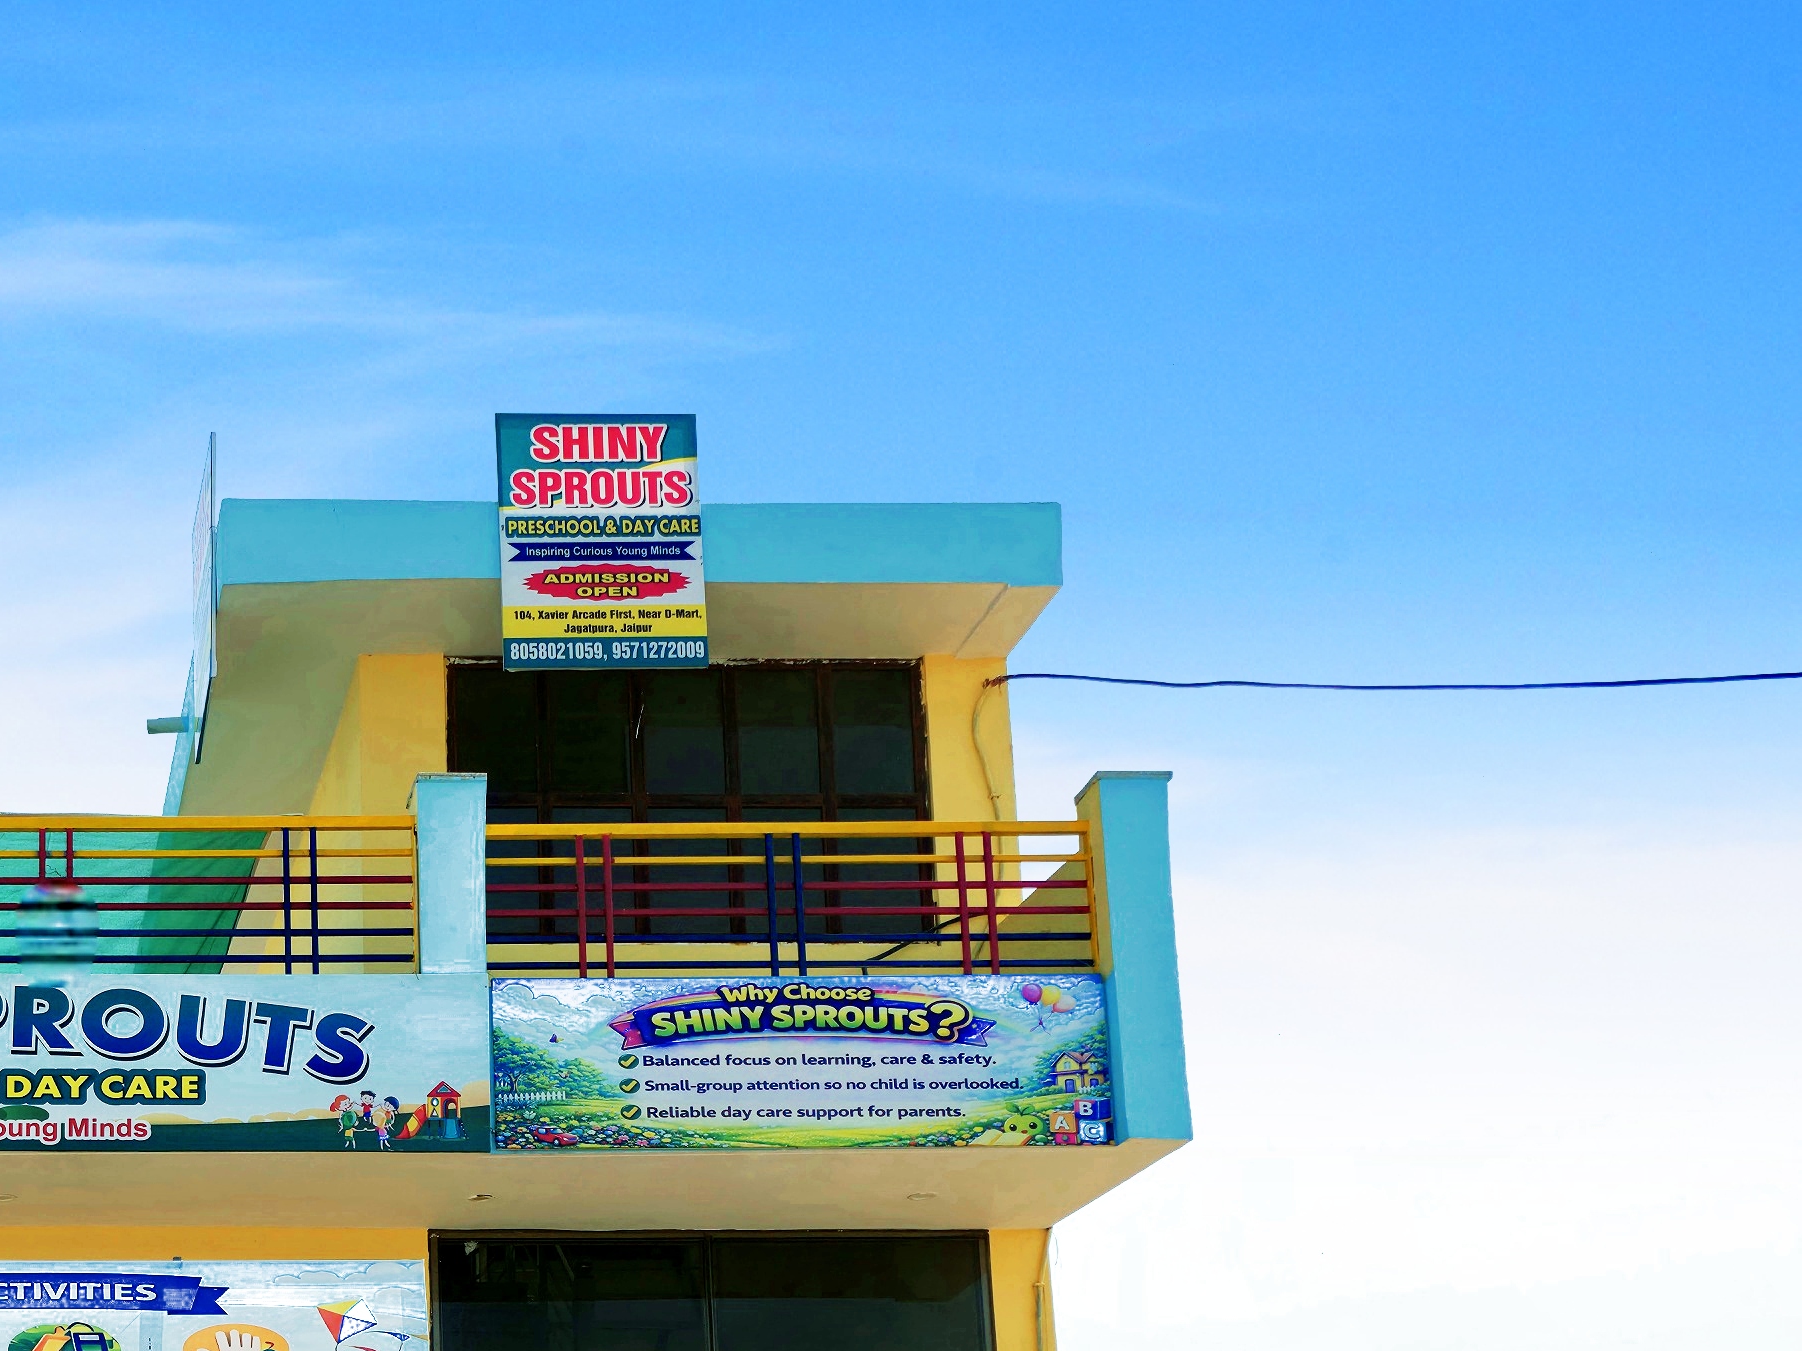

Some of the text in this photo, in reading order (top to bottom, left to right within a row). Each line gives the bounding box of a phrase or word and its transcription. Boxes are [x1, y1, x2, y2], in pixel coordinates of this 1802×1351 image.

[532, 425, 666, 461] SHINY
[511, 470, 690, 507] SPROUTS
[508, 519, 699, 534] PRESCHOOL & DAY CARE
[526, 545, 681, 558] Inspiring Curious Young Minds
[544, 573, 670, 584] ADMISSION
[576, 586, 638, 597] OPEN
[514, 609, 702, 621] 104, Xavier Arcade First, Near D-Mart,
[564, 623, 652, 634] Jagatpura, Jaipur
[510, 641, 705, 661] 8058021059, 9571272009
[720, 985, 872, 1003] Why Choose
[651, 1001, 966, 1037] SHINY SPROUTS?
[642, 1053, 997, 1068] Balanced focus on learning, care & safety.
[6, 1075, 91, 1099] DAY
[100, 1075, 200, 1099] CARE
[644, 1078, 1024, 1093] Small-group attention so no child is overlooked.
[646, 1105, 966, 1120] Reliable day care support for parents.
[1078, 1101, 1093, 1116] B
[68, 1118, 148, 1138] Minds
[1054, 1115, 1070, 1130] A
